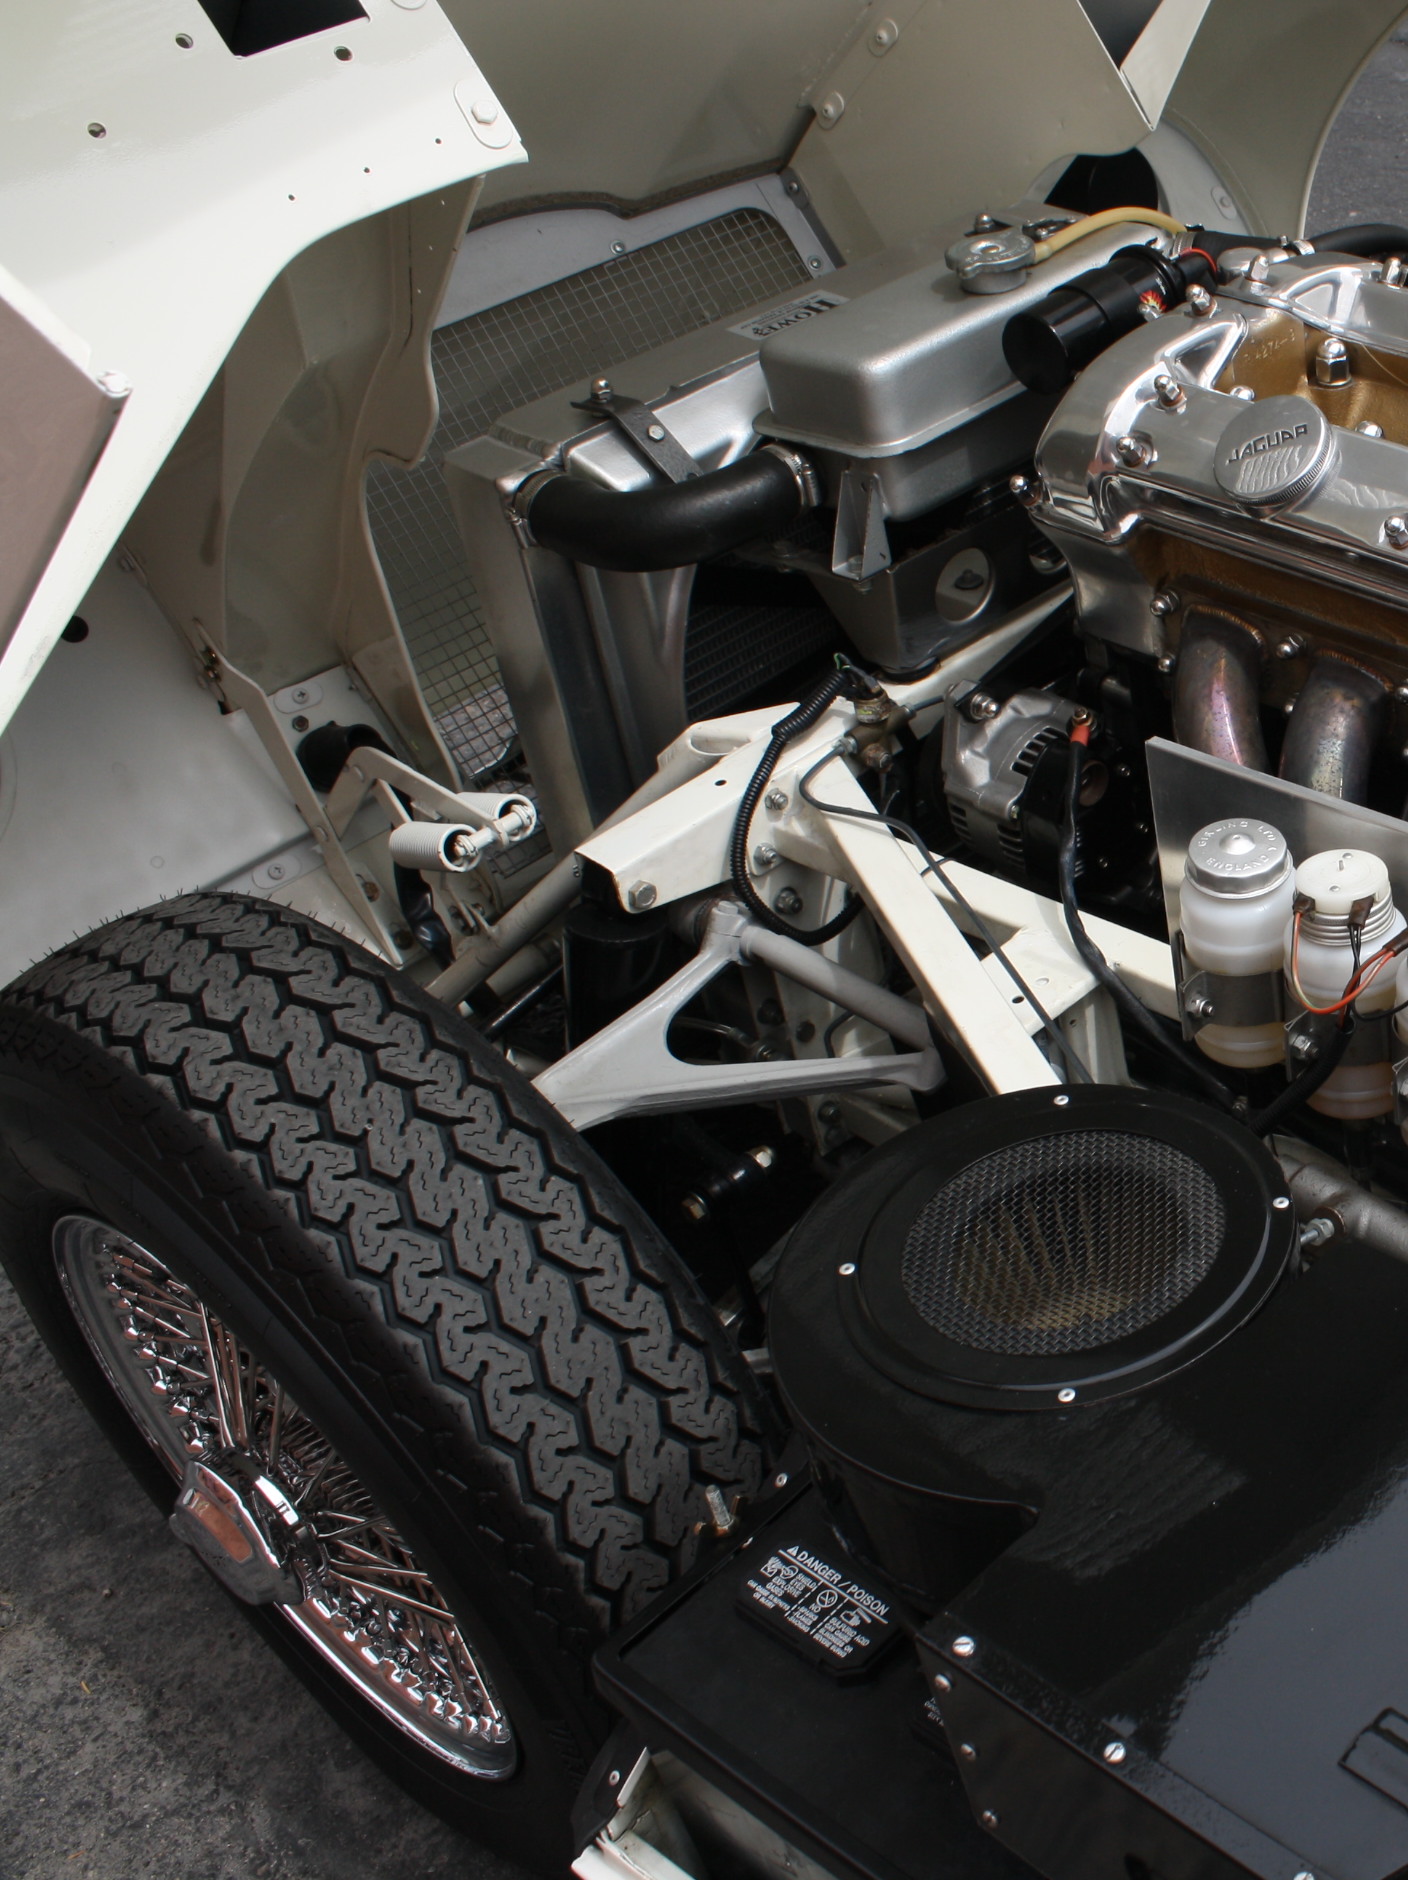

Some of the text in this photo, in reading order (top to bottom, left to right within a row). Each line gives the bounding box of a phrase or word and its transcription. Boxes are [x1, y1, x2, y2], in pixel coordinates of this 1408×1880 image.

[1225, 423, 1308, 466] JAGUAR
[1206, 854, 1270, 871] ENGLAND
[772, 1576, 802, 1598] EXPLOSIVE
[789, 1578, 806, 1591] EYES
[796, 1573, 817, 1589] SHIELD
[796, 1550, 842, 1584] DANGER
[846, 1584, 890, 1616] POISON
[766, 1582, 785, 1597] GASES
[809, 1603, 821, 1613] NO
[853, 1634, 870, 1646] ACID
